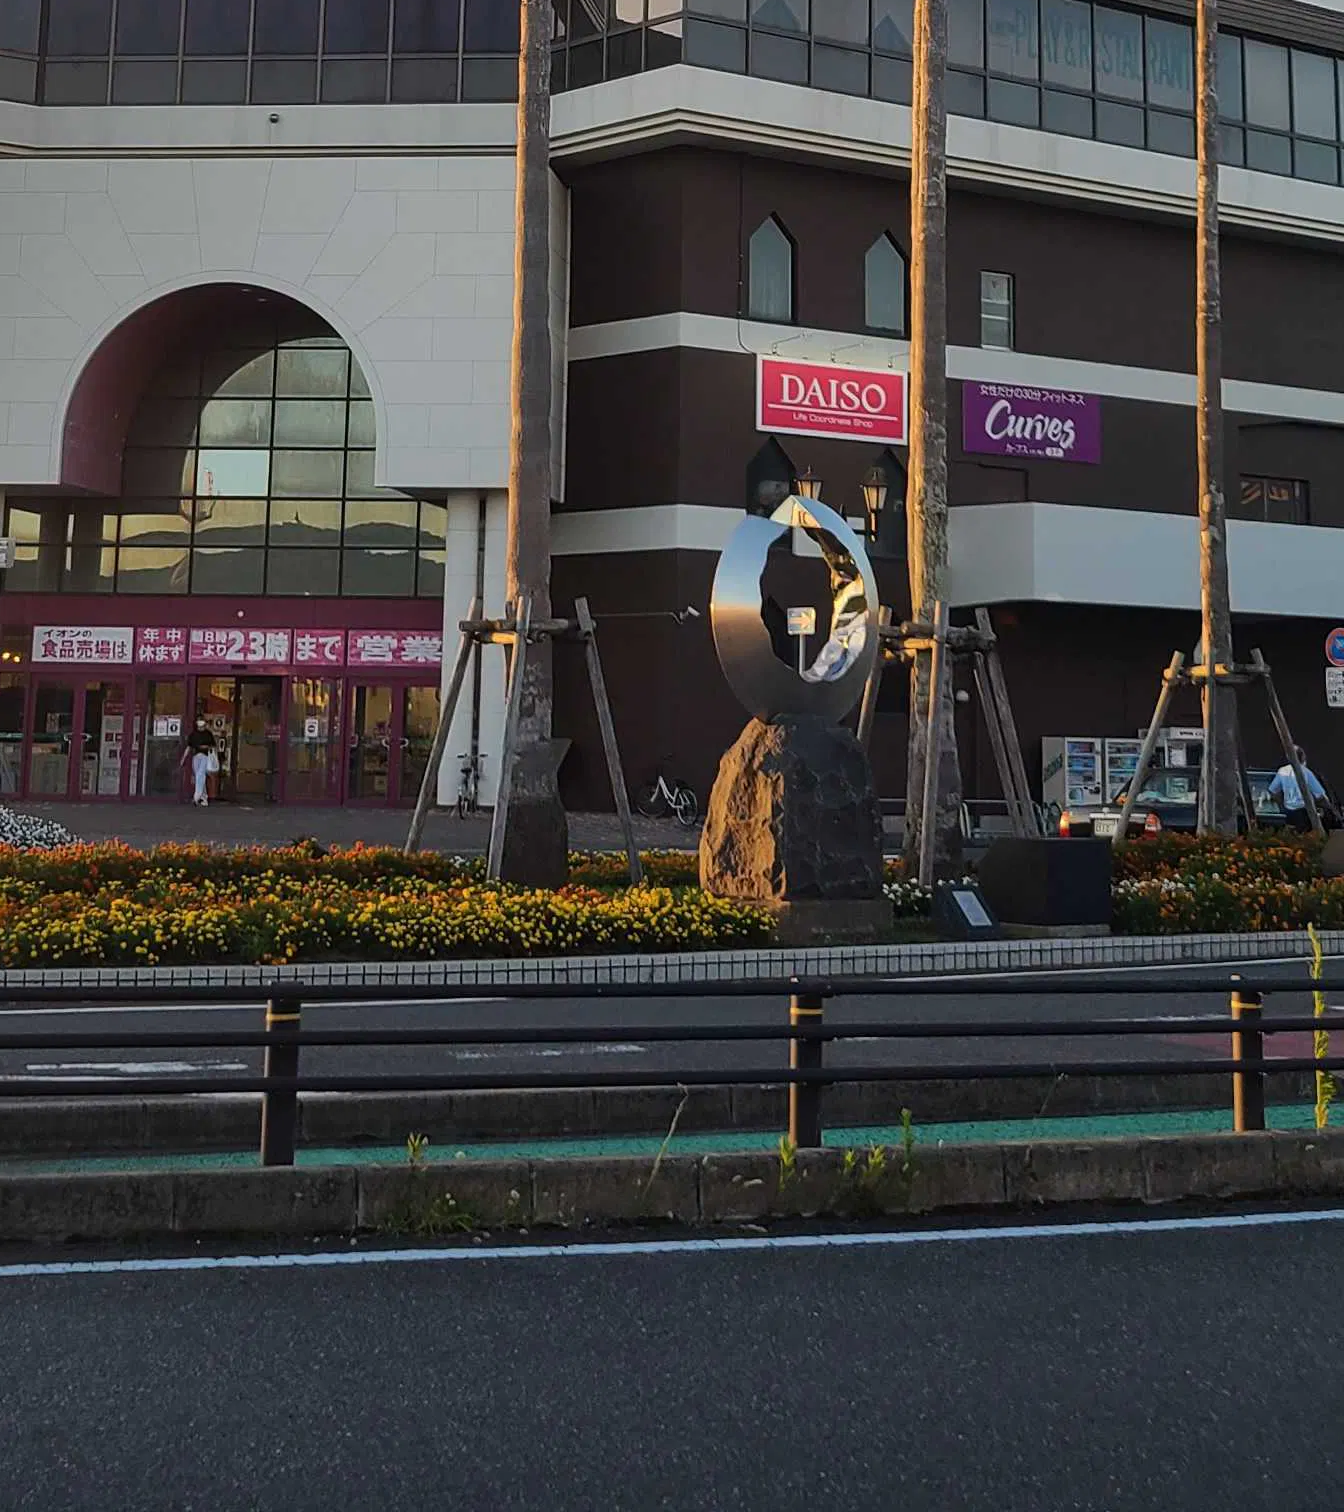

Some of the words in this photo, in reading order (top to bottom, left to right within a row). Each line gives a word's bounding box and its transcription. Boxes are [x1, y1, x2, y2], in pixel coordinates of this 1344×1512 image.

[780, 373, 887, 414] DAISO
[985, 399, 1075, 450] Curves
[43, 629, 92, 638] イオンの
[143, 628, 182, 643] 年中
[41, 639, 128, 660] 食品売場は
[139, 644, 185, 663] 休まず
